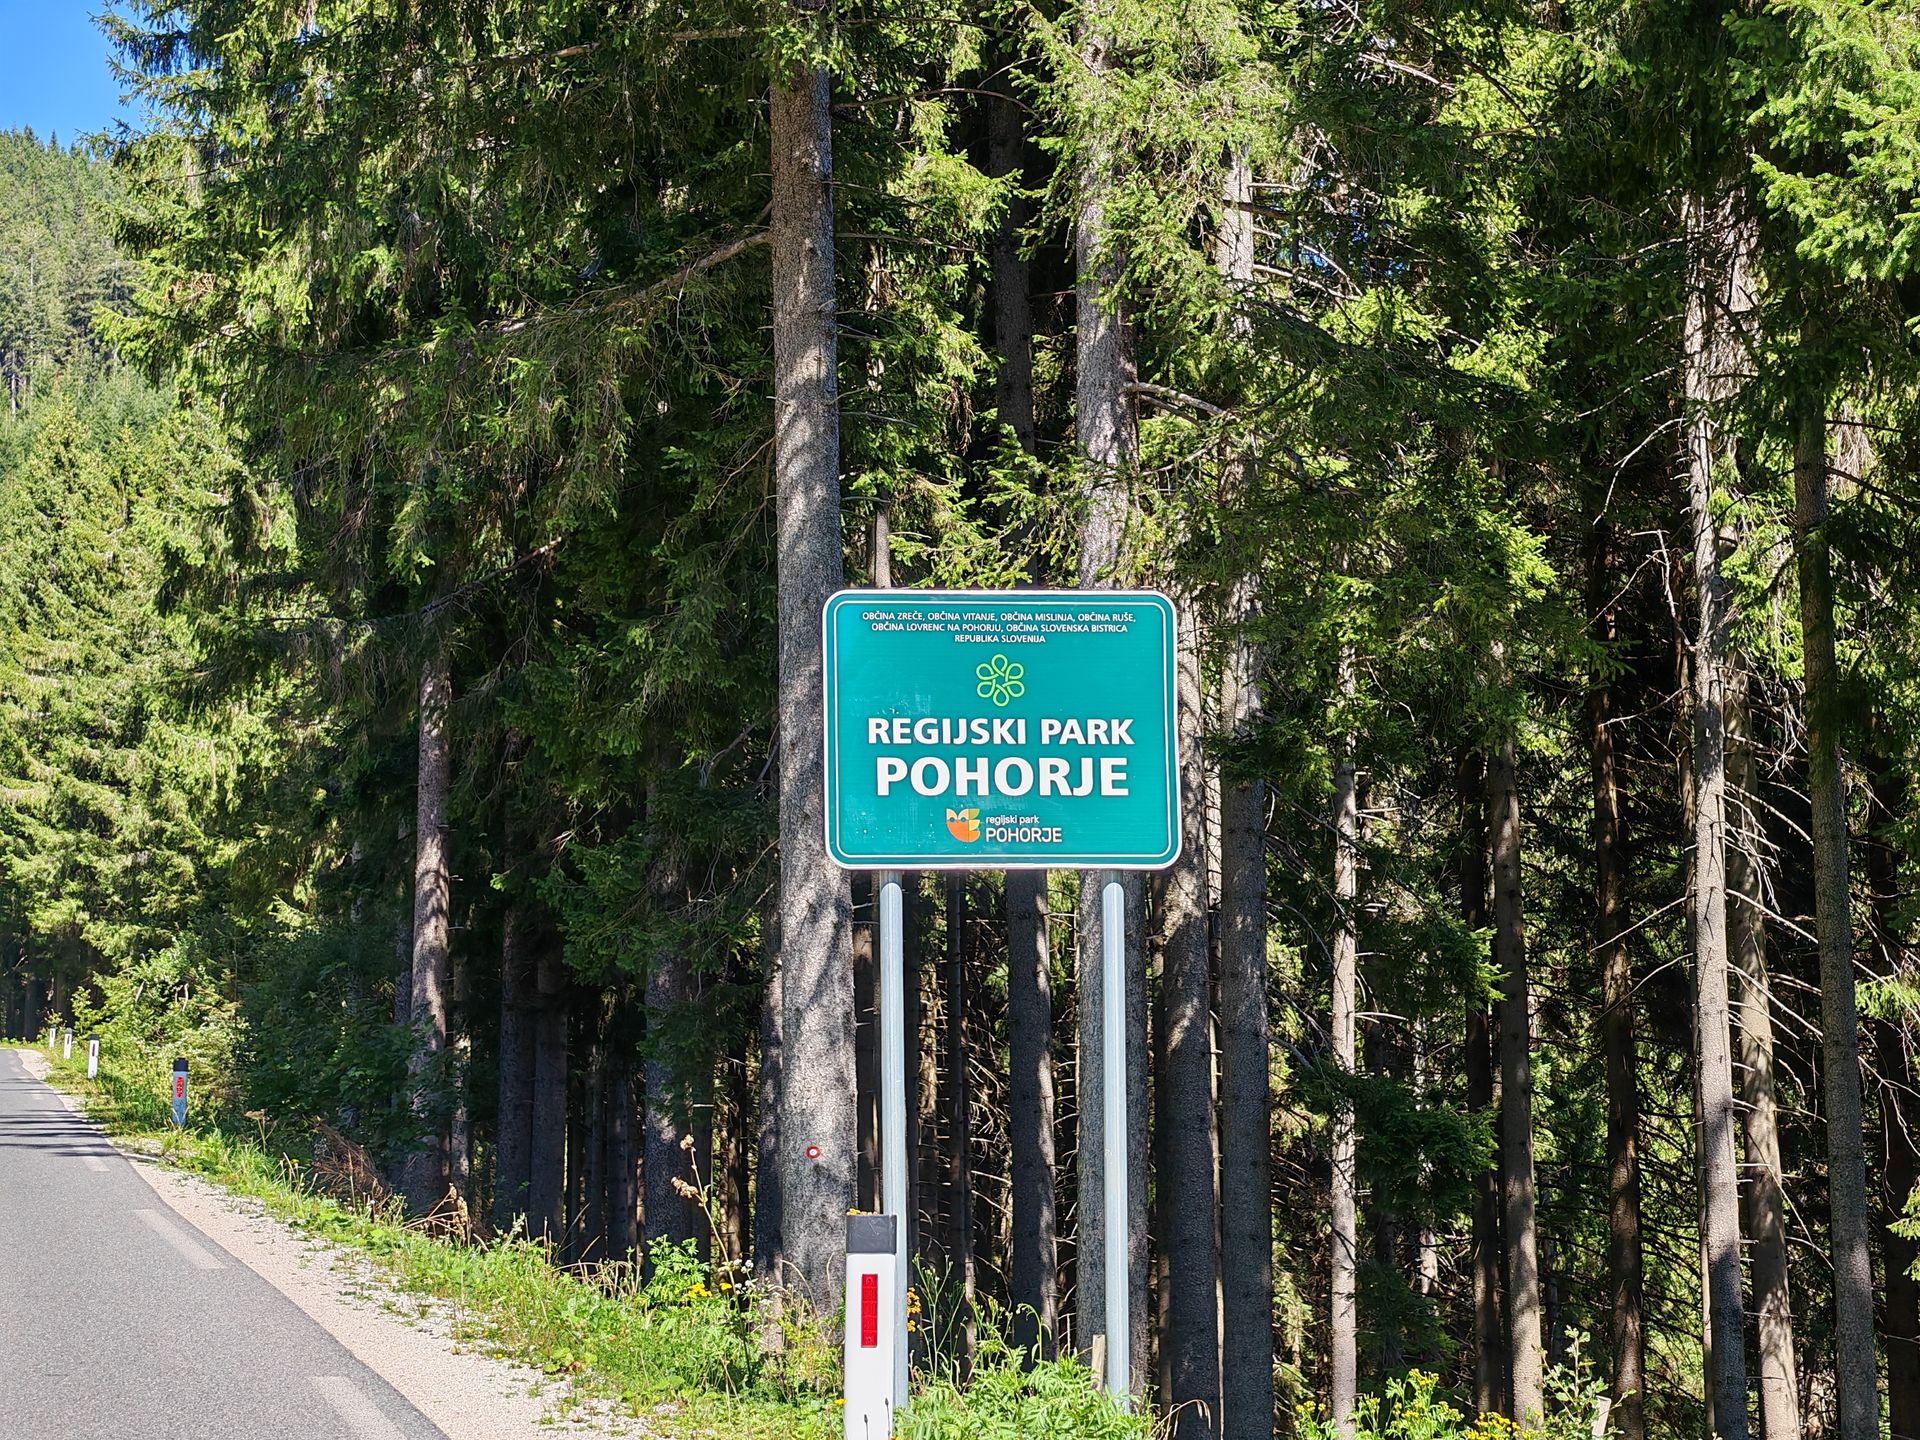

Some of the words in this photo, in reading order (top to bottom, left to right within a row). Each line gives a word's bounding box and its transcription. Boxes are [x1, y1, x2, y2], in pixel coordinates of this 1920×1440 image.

[862, 610, 896, 620] OBČINA
[897, 610, 926, 622] ZREČE,
[928, 610, 961, 621] OBČINA
[963, 612, 998, 623] VITANJE,
[1000, 611, 1034, 622] OBČINA
[1035, 613, 1076, 623] MISLINJA,
[1078, 611, 1111, 622] OBČINA
[1113, 612, 1136, 623] RUŠE,
[871, 621, 905, 631] OBČINA
[907, 623, 945, 632] LOVRENC
[947, 624, 961, 632] NA
[963, 624, 1004, 633] POHORJU,
[1006, 622, 1039, 632] OBČINA
[1041, 624, 1089, 633] SLOVENSKA
[1091, 624, 1128, 633] BISTRICA
[954, 634, 999, 643] REPUBLIKA
[1001, 634, 1046, 643] SLOVENIJA
[868, 717, 1026, 745] REGIJSKI
[1040, 718, 1135, 745] PARK
[876, 756, 1129, 797] POHORJE
[985, 814, 1018, 826] regijski
[1019, 815, 1040, 826] park
[985, 827, 1063, 843] POHORJE
